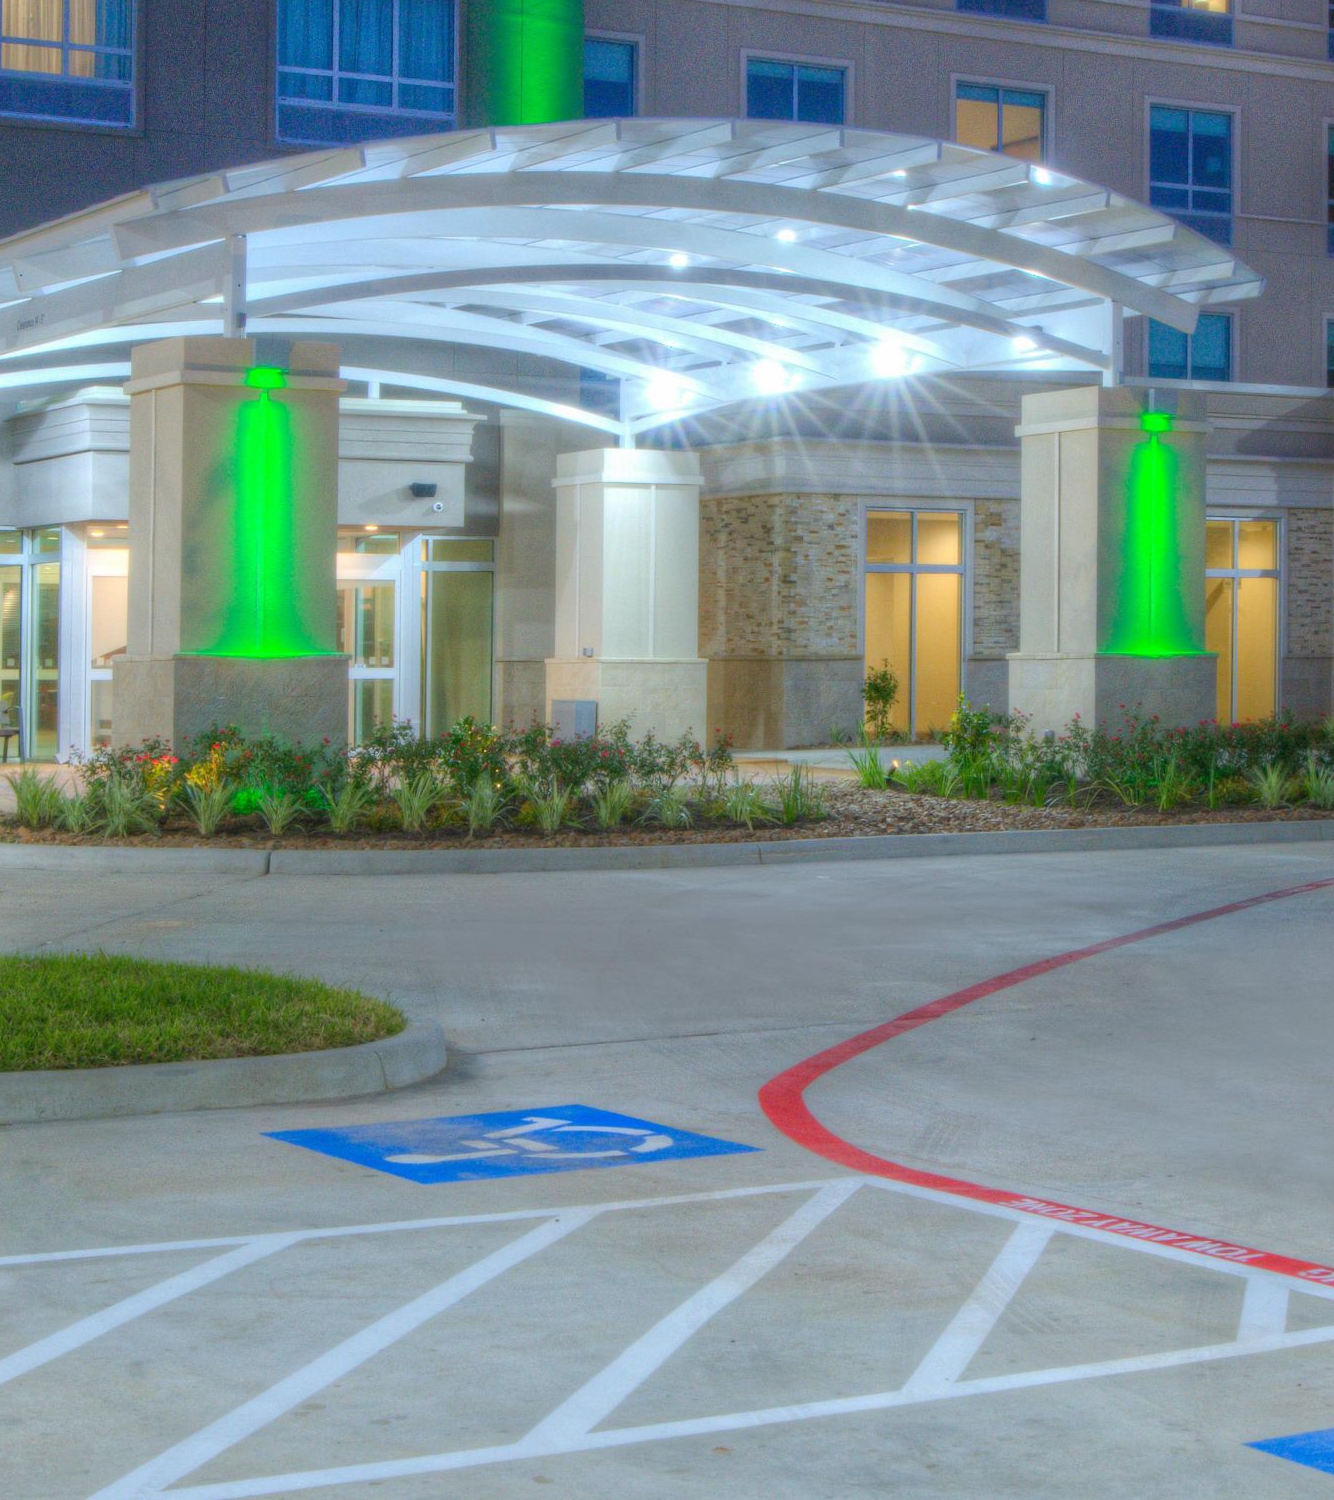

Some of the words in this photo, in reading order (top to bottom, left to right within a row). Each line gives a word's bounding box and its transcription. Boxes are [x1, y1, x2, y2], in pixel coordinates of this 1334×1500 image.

[999, 1198, 1099, 1221] ZONE
[1081, 1219, 1191, 1242] AWAY
[1173, 1240, 1266, 1262] TOW
